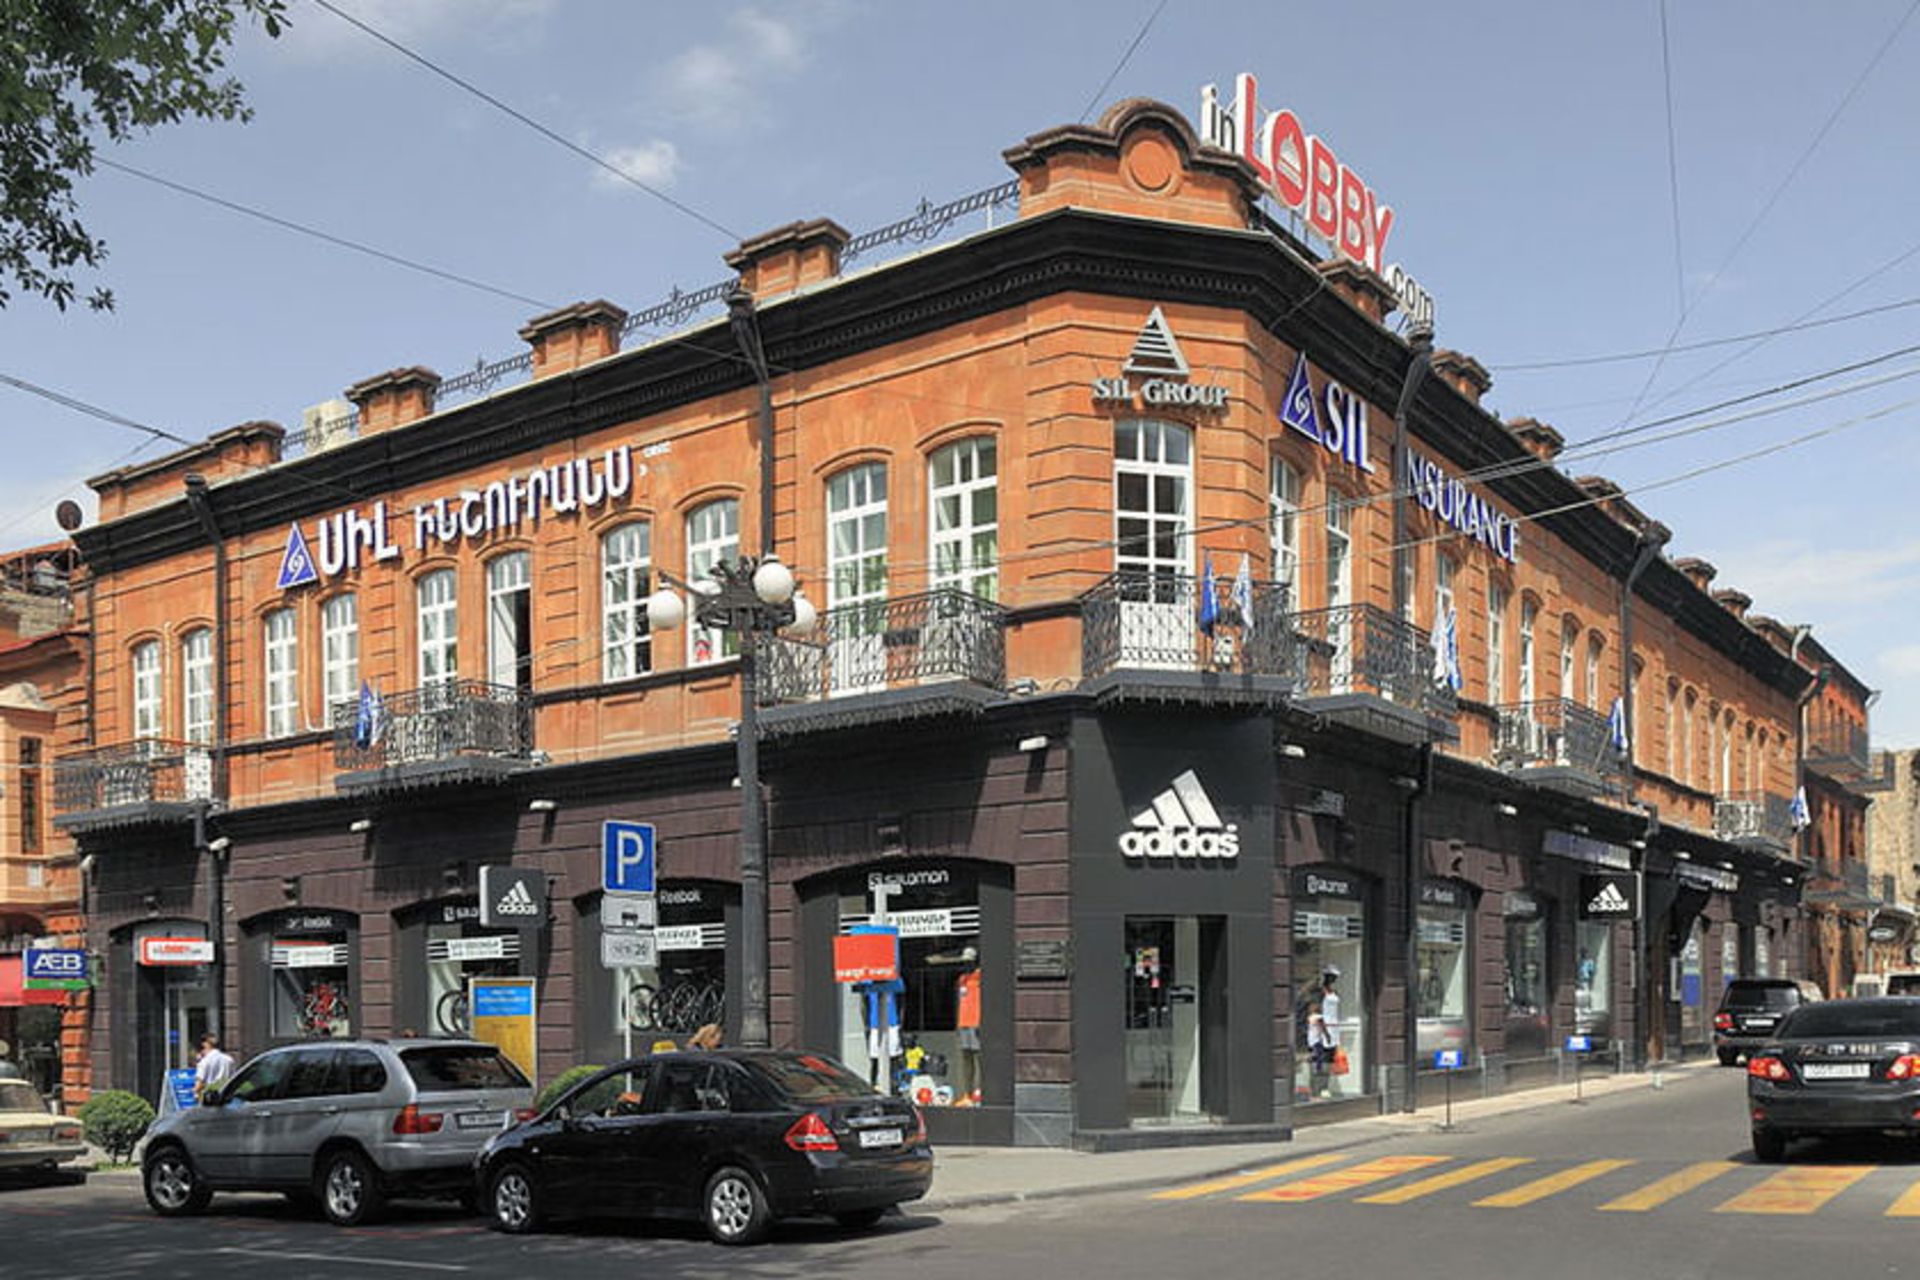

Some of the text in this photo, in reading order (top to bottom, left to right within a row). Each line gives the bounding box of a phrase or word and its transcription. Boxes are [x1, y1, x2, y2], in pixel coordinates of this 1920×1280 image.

[1091, 377, 1229, 407] SIL GROUP
[1324, 381, 1520, 564] SIL NSURANCE
[616, 829, 644, 885] P
[1118, 823, 1240, 859] adidas
